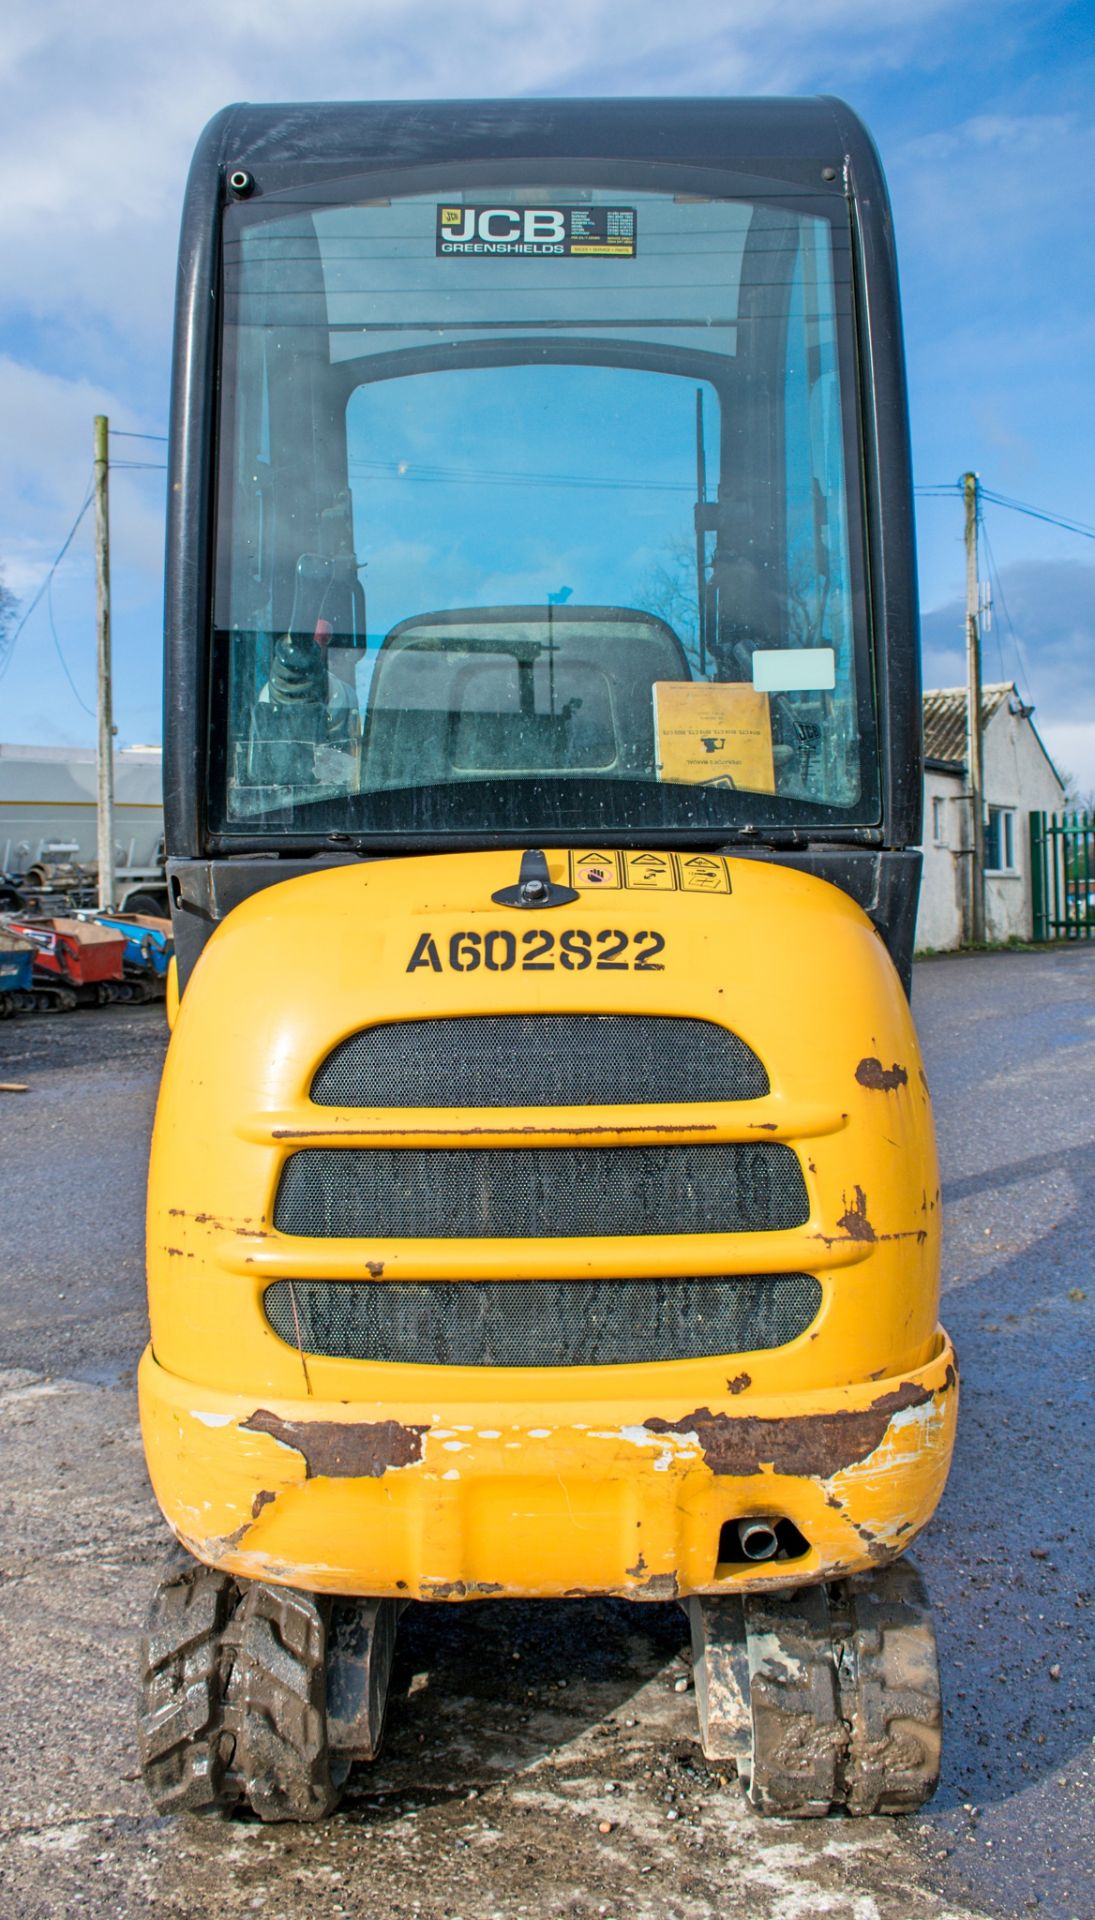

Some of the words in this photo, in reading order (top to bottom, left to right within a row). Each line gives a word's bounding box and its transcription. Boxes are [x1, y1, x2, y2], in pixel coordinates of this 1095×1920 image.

[441, 209, 566, 243] JCB
[441, 243, 565, 254] GREENSHIELDS
[406, 929, 665, 972] A602S22
